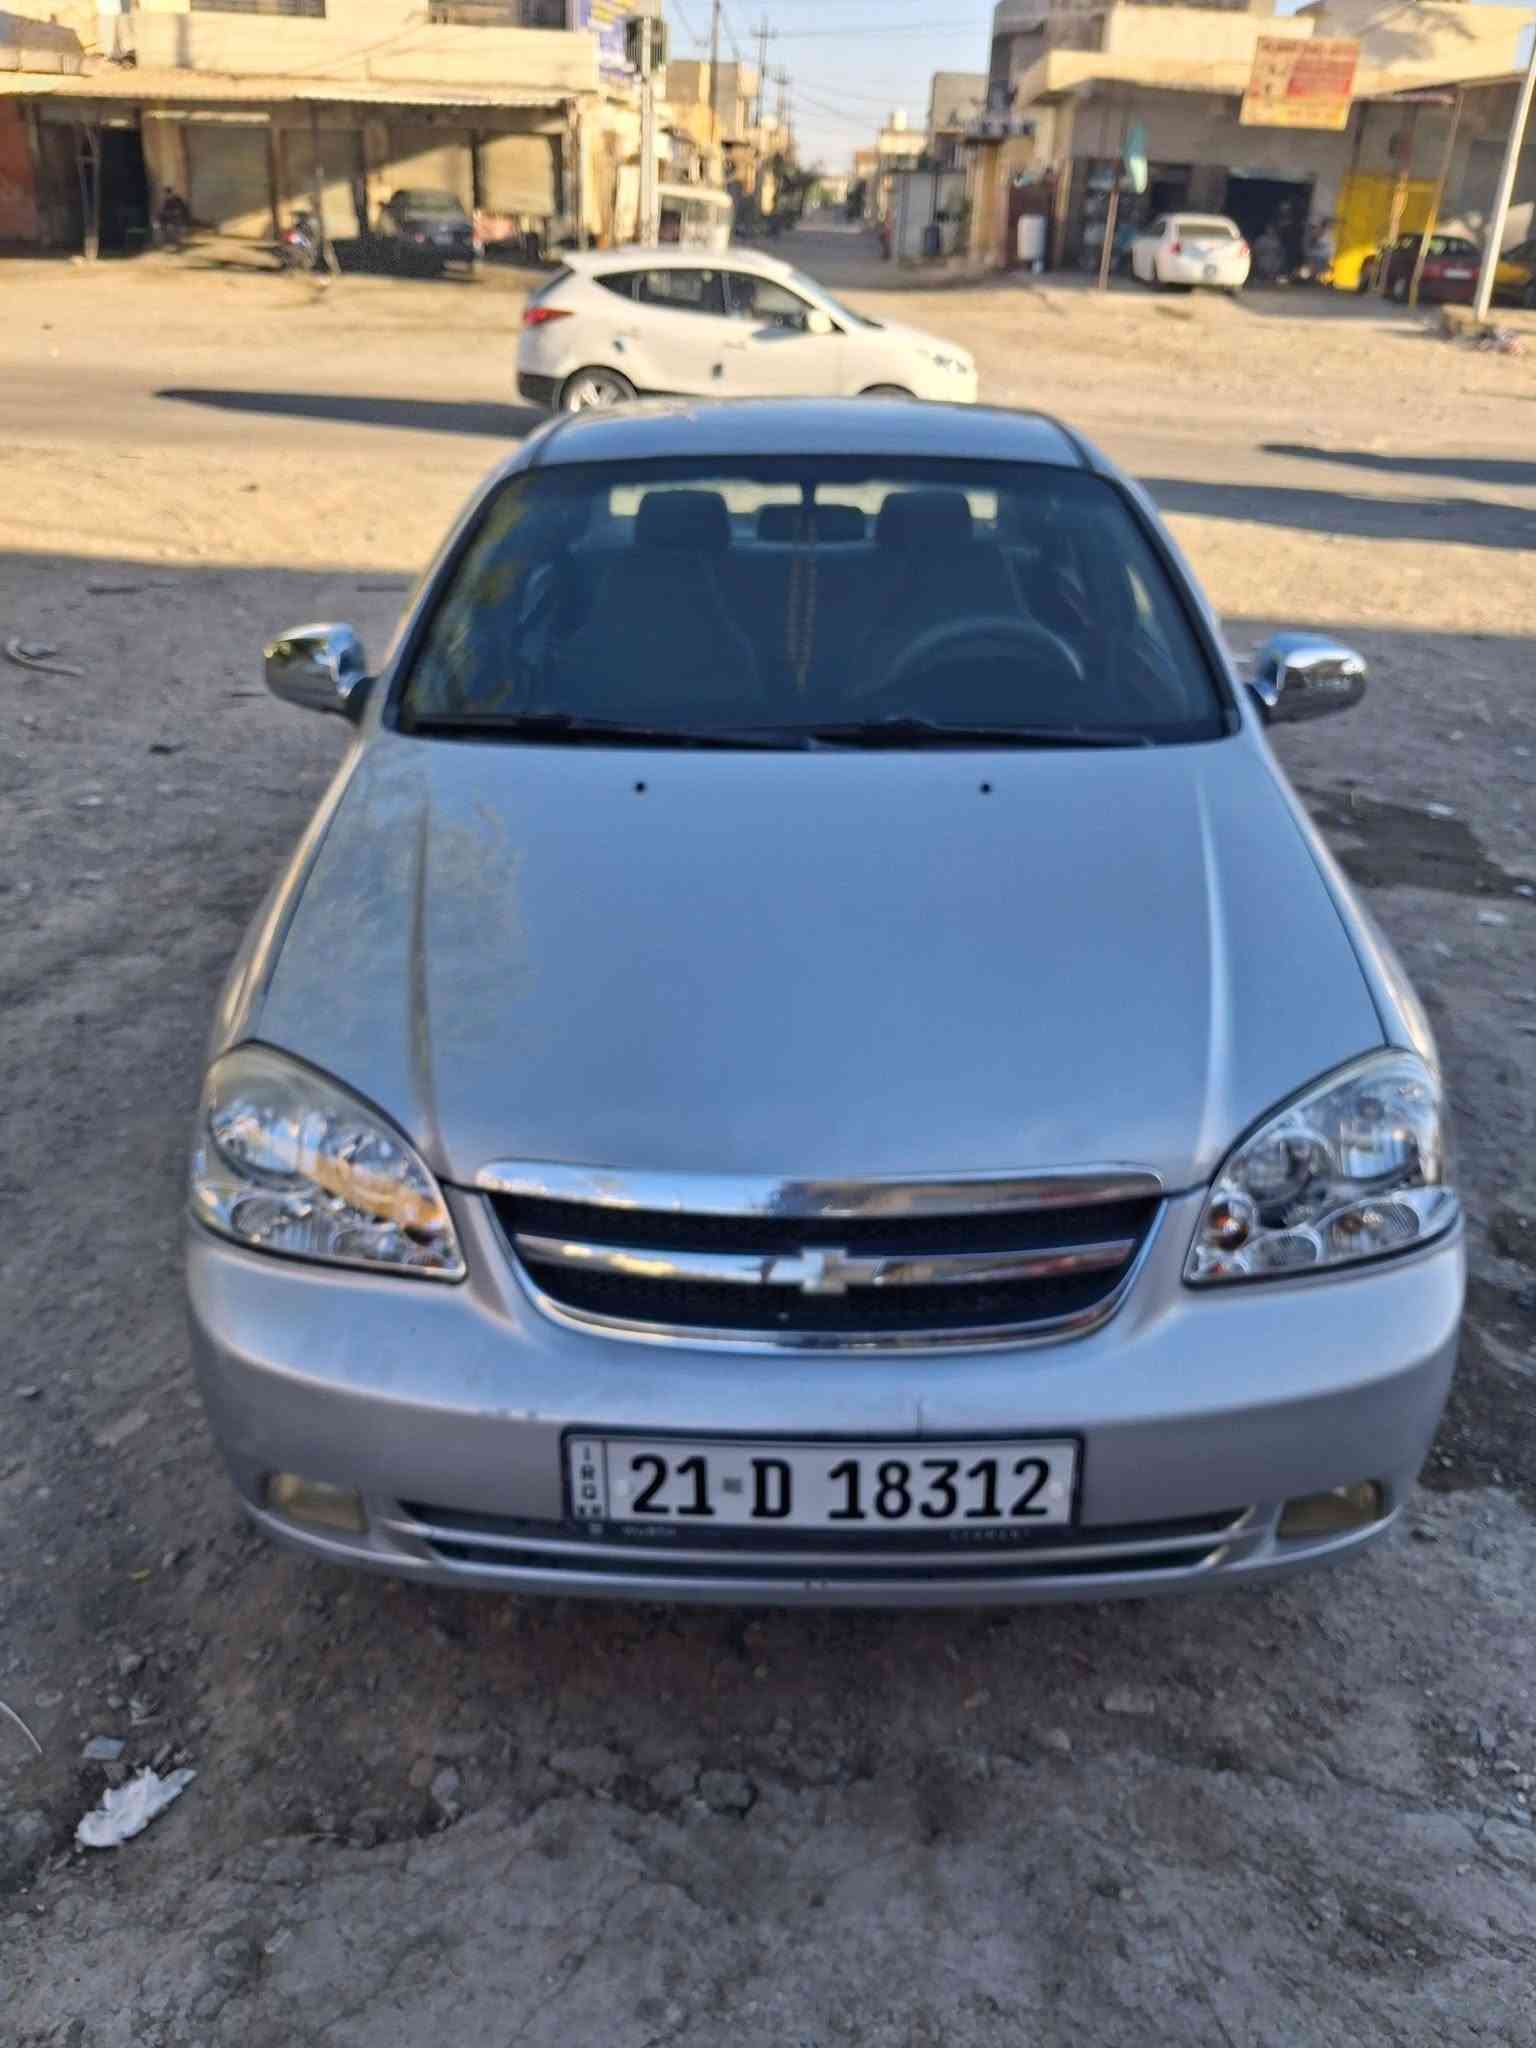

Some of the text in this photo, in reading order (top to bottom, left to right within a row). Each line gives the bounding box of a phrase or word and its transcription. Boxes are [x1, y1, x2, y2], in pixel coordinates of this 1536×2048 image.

[631, 1454, 1050, 1519] 21 D 18312
